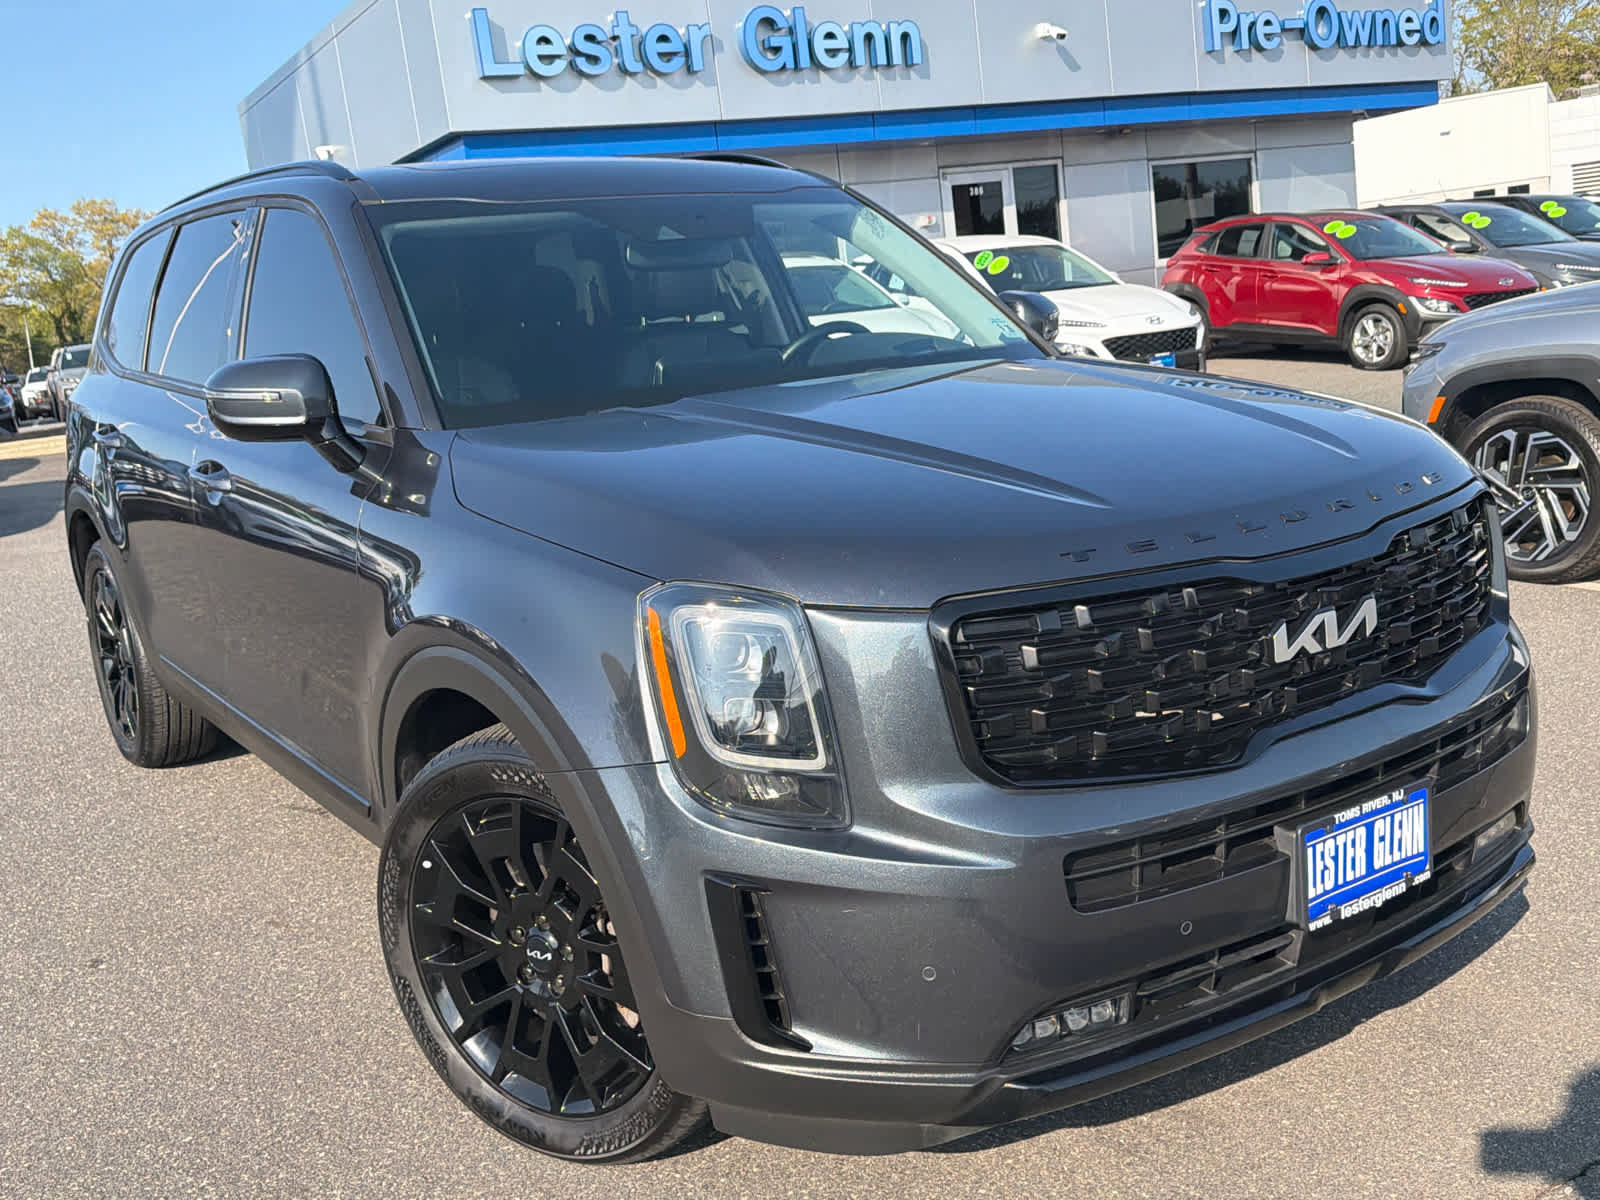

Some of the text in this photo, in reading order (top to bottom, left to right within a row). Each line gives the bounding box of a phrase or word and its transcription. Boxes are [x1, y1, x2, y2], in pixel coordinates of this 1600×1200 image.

[470, 4, 924, 80] Lester Glenn
[1203, 0, 1446, 53] Pre-Owned
[1058, 471, 1443, 563] TELLURIDE
[1273, 594, 1378, 664] KIA
[1333, 806, 1361, 824] TOMS
[1392, 789, 1404, 802] NJ
[1307, 803, 1425, 899] LESTER GLENN
